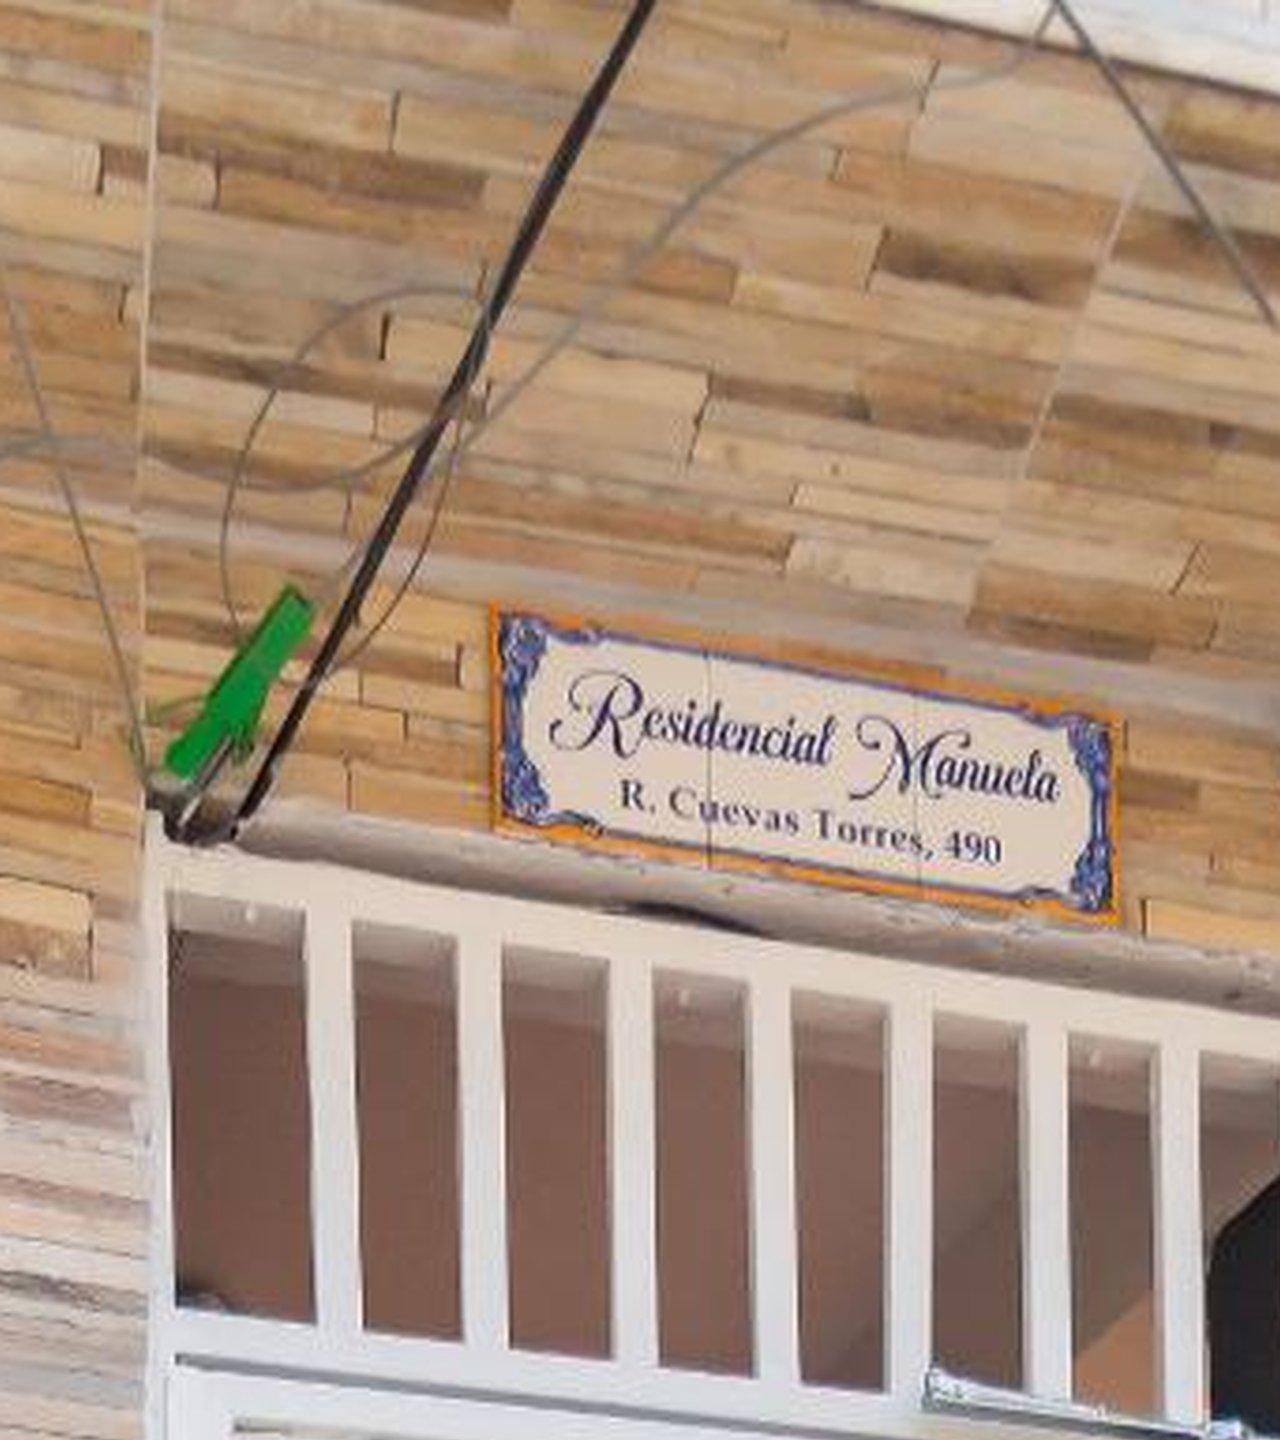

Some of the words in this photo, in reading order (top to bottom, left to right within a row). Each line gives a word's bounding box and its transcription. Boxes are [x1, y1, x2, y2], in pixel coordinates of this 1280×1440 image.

[549, 669, 836, 766] Residencial
[849, 714, 1060, 803] Manuela
[621, 778, 656, 814] R.
[669, 785, 799, 835] Cuevas
[813, 809, 935, 861] Torres,
[943, 830, 1003, 866] 490
